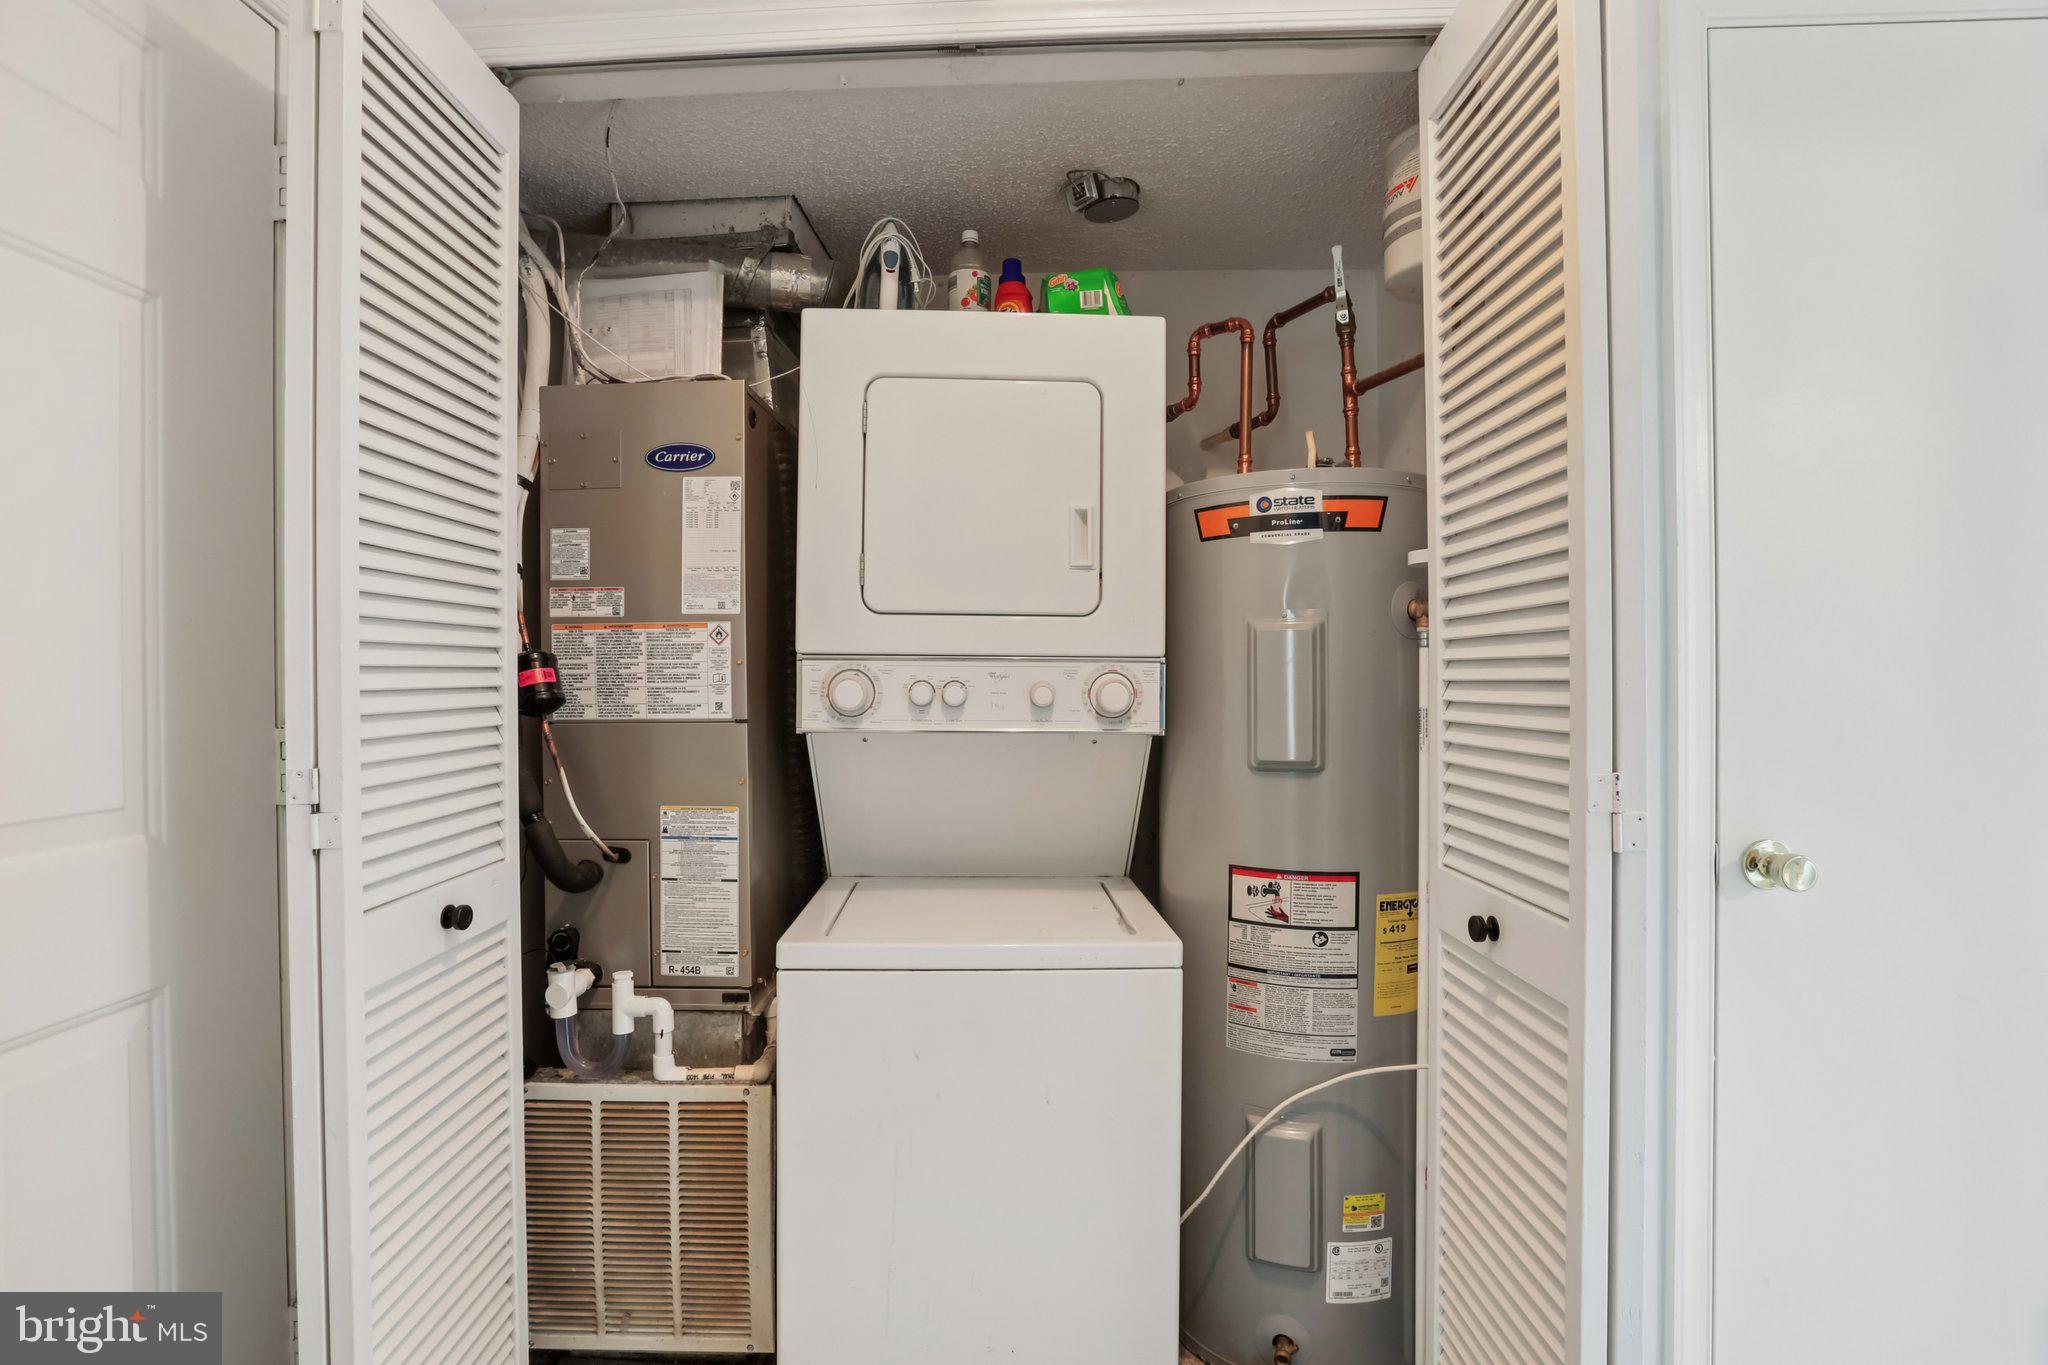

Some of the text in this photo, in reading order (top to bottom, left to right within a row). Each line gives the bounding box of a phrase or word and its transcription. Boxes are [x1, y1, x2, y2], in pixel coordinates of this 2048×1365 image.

[655, 451, 705, 462] Carrier
[1273, 495, 1315, 507] state
[1389, 923, 1406, 933] 419
[680, 965, 702, 975] 454B
